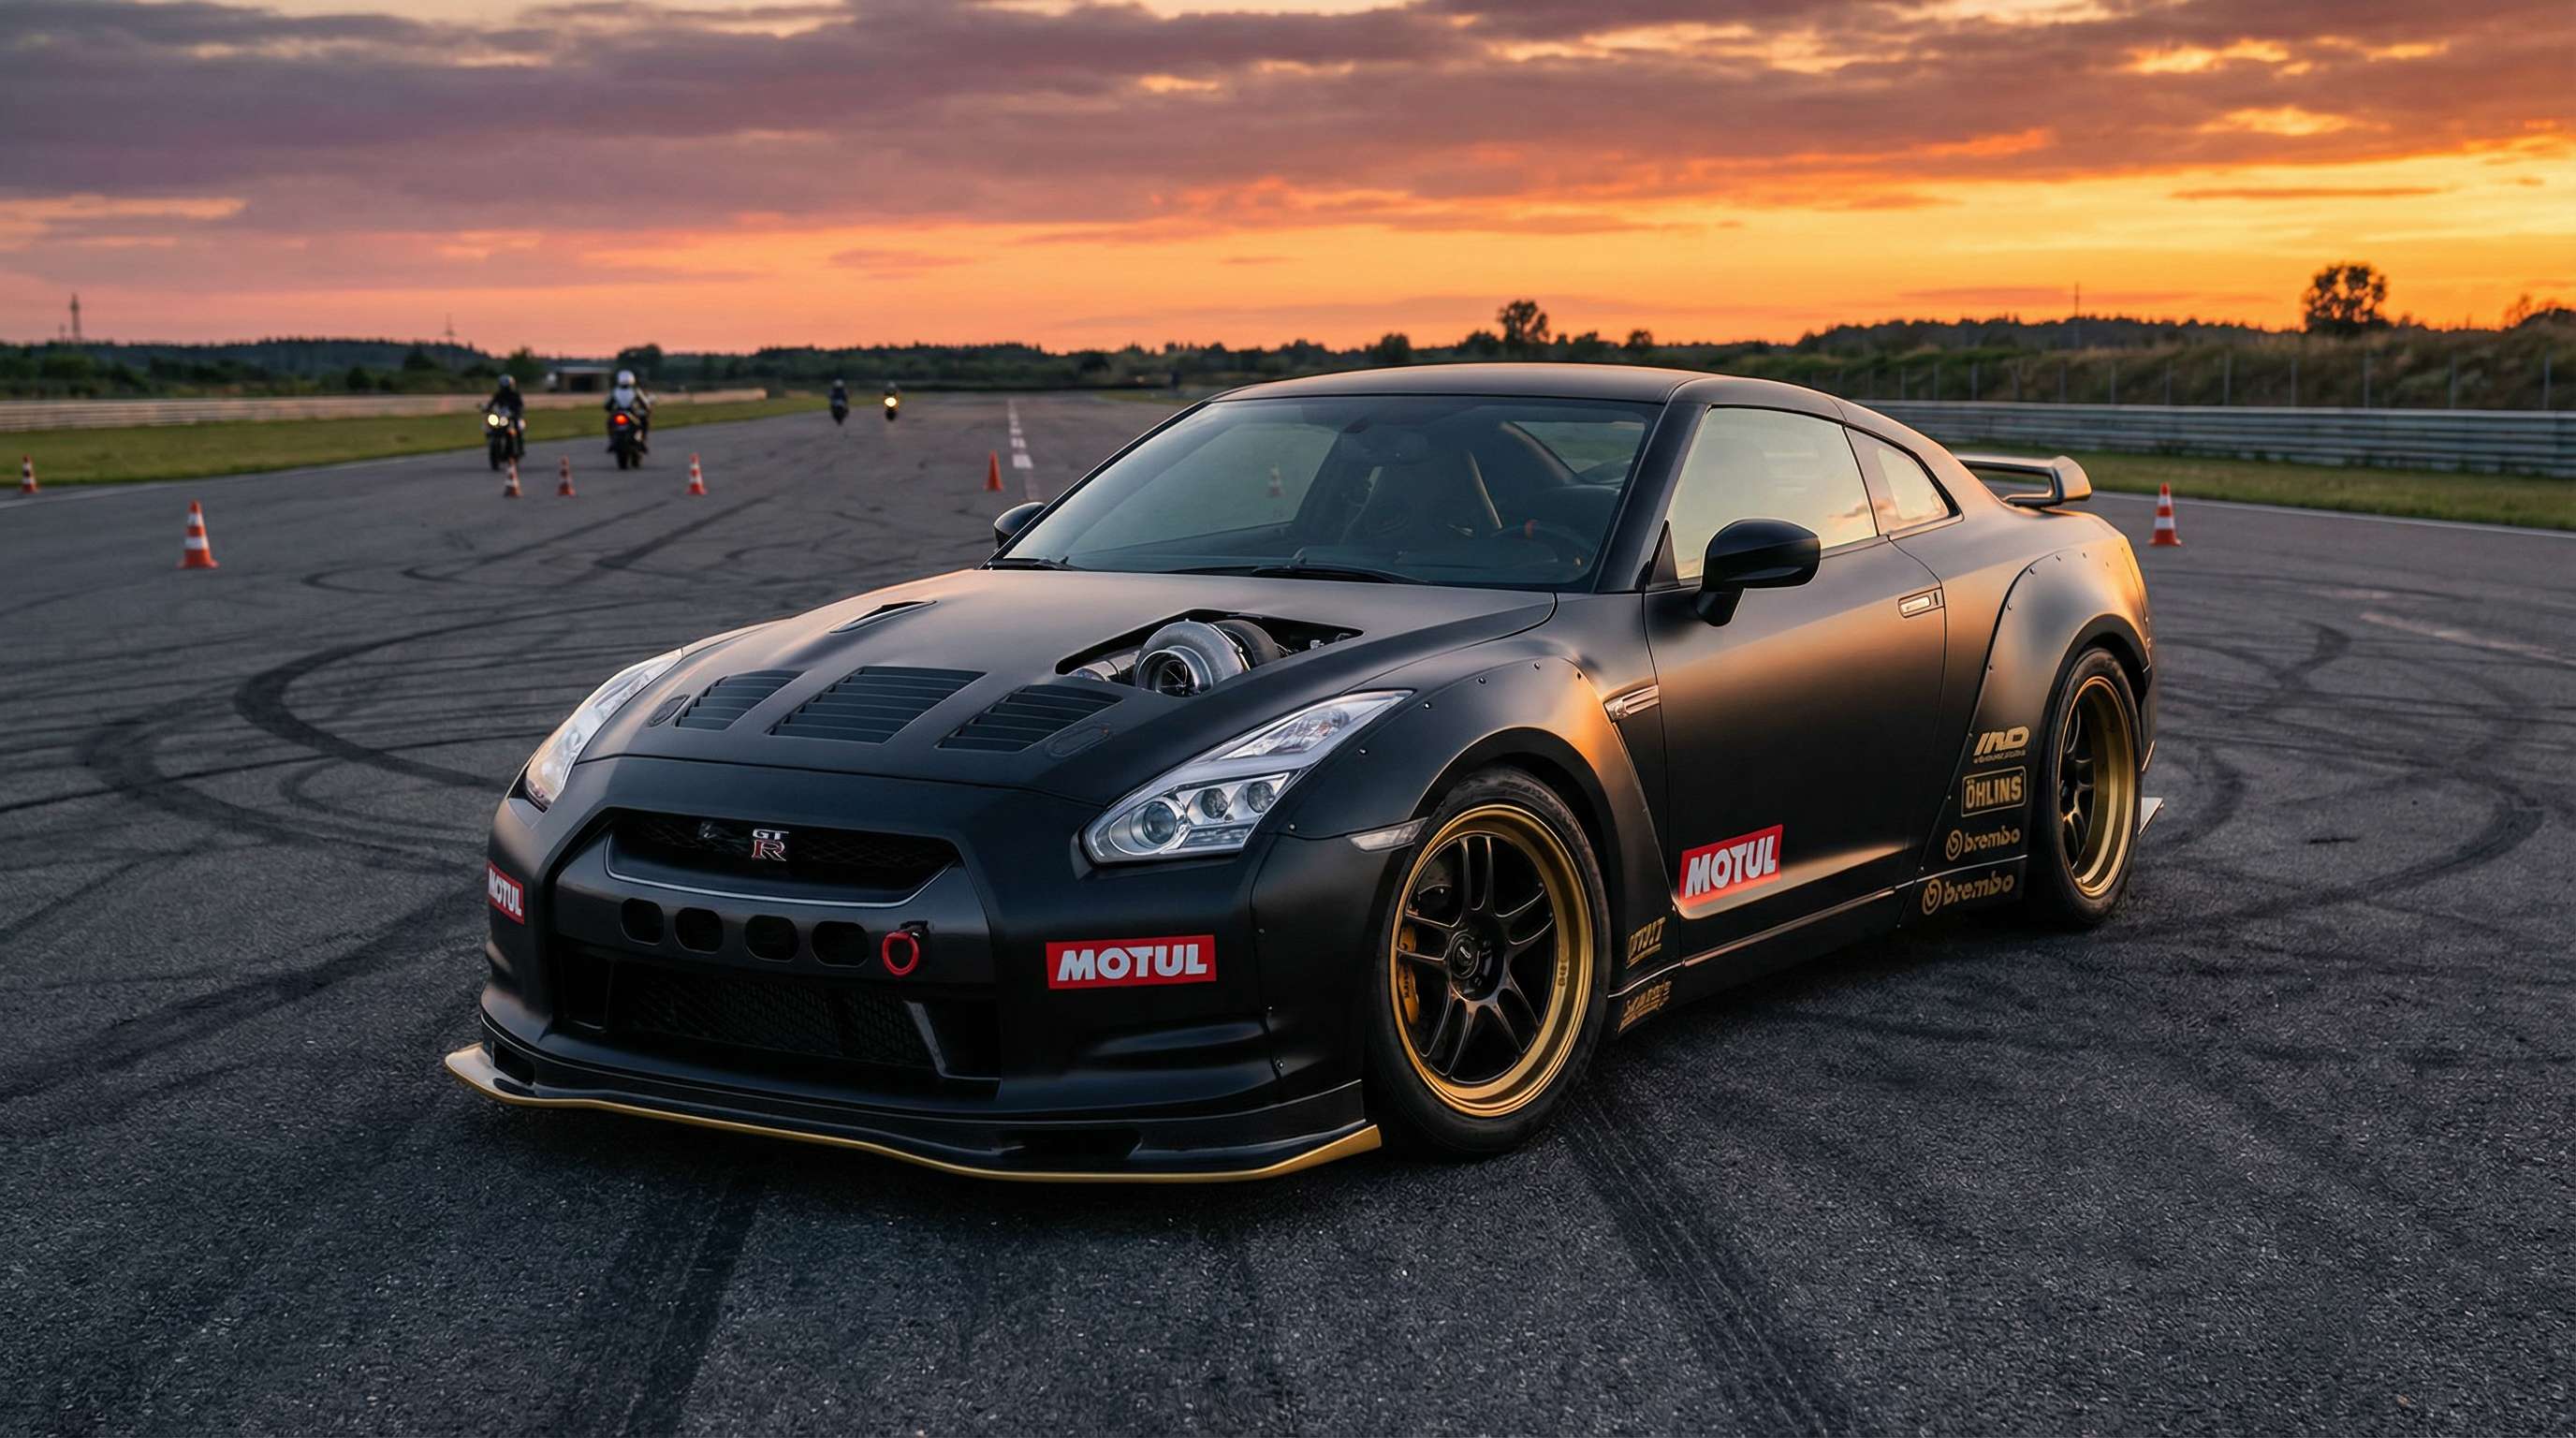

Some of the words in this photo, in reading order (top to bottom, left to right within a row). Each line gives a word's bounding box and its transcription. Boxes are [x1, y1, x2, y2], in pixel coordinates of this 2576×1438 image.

[1966, 778, 2022, 809] ÖHLINS
[1964, 825, 2021, 853] brembo
[1685, 835, 1777, 899] MOTUL
[488, 868, 522, 917] MOTUL
[1943, 871, 2014, 905] brembo
[1057, 944, 1208, 981] MOTUL
